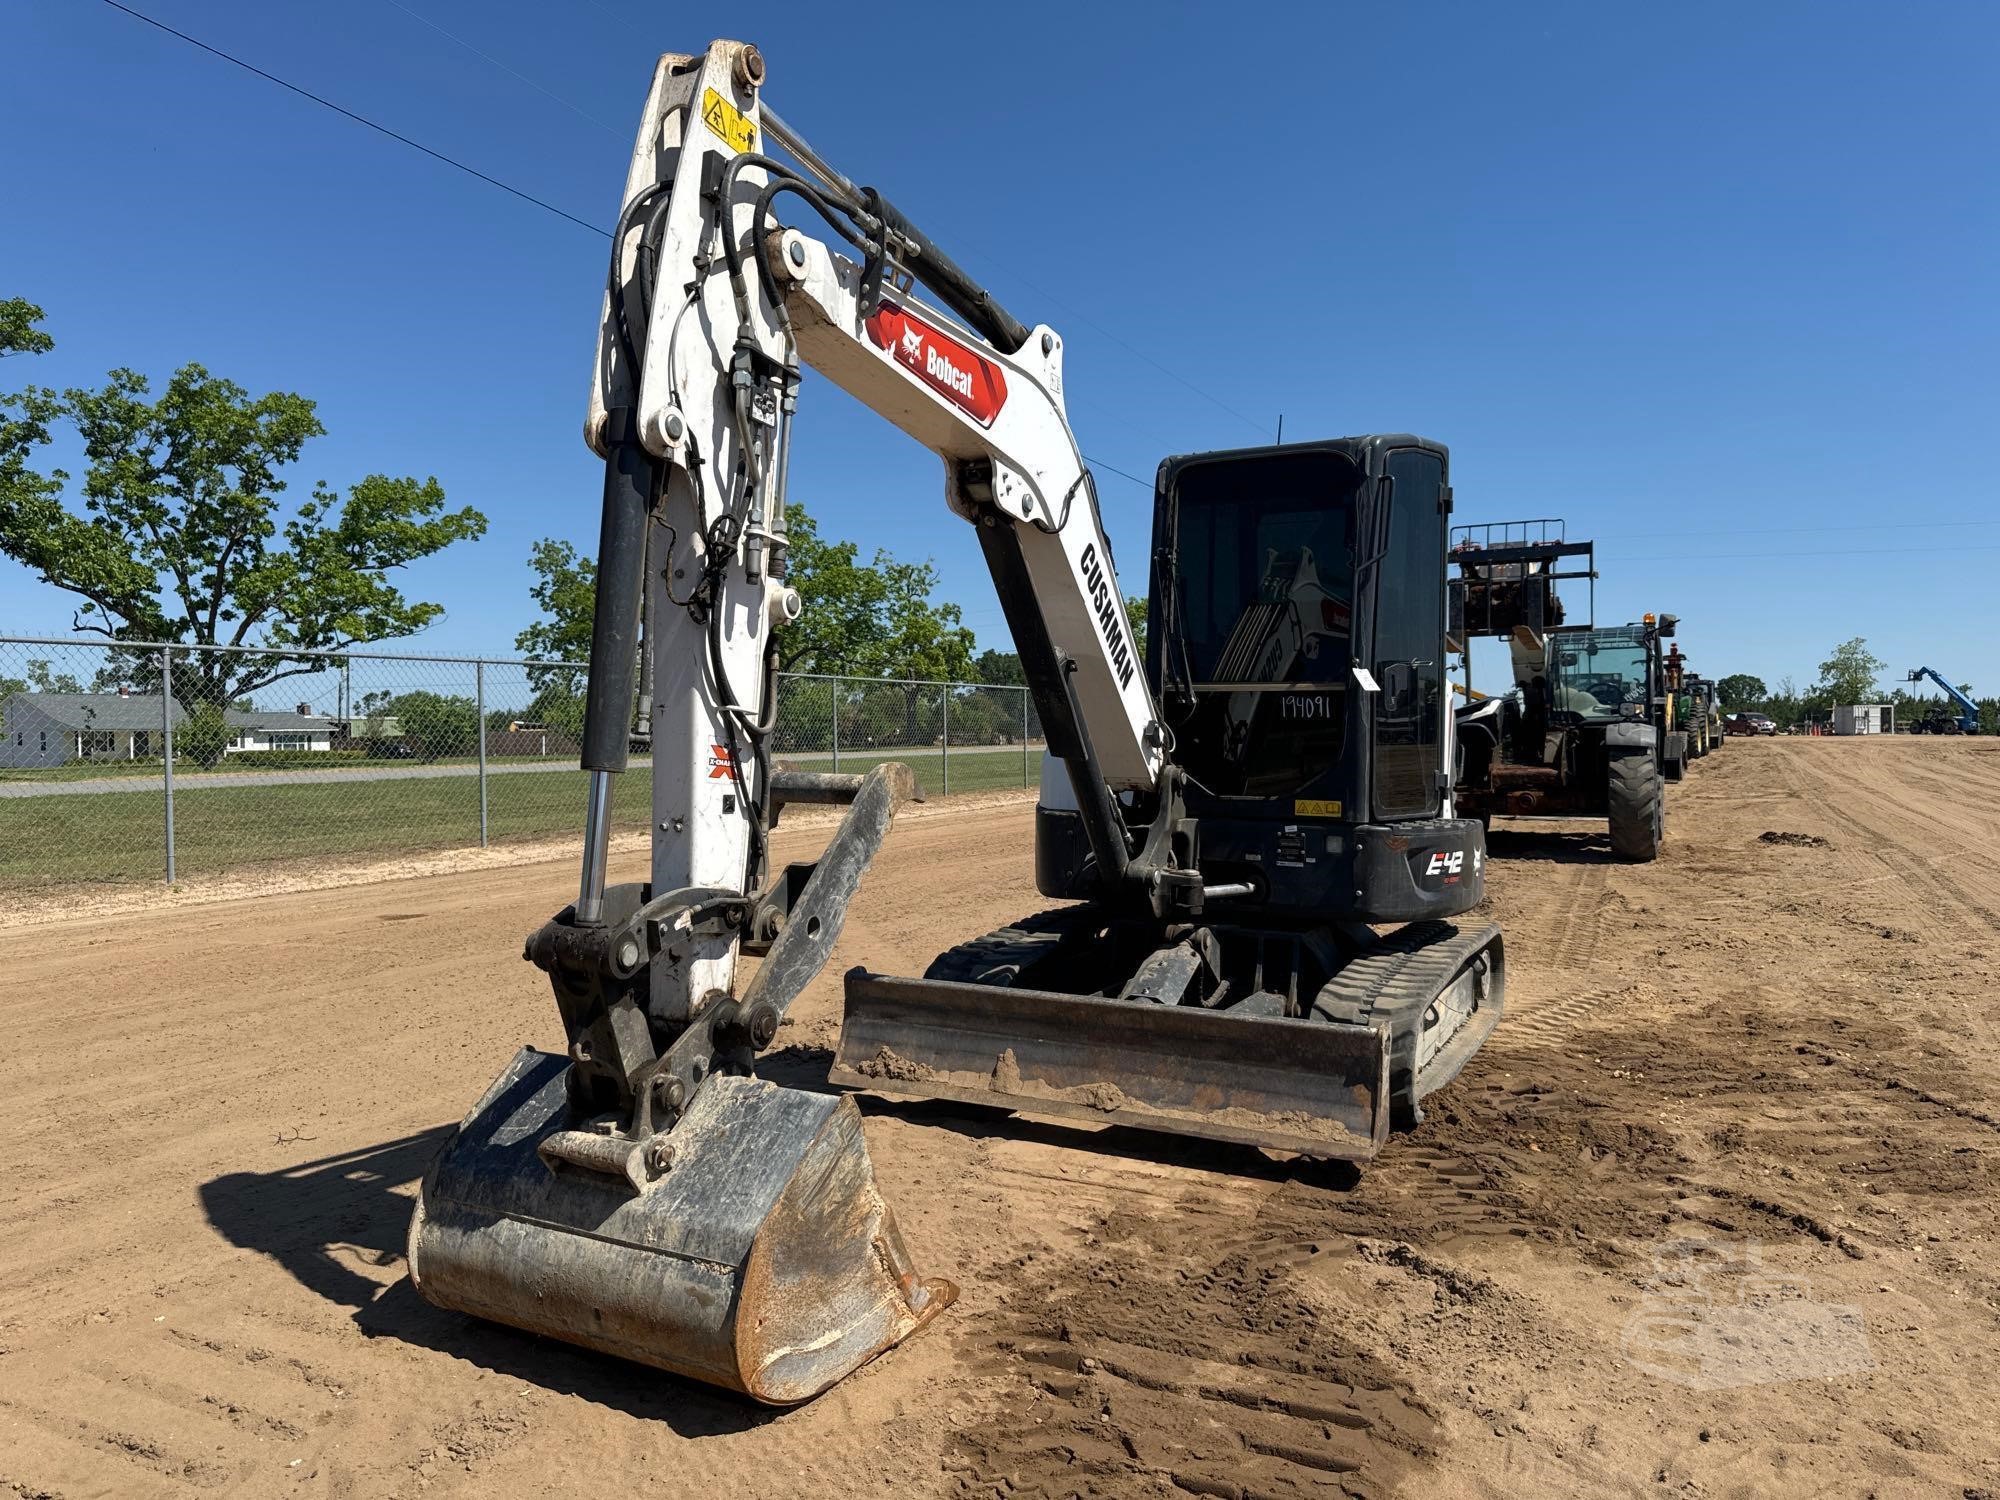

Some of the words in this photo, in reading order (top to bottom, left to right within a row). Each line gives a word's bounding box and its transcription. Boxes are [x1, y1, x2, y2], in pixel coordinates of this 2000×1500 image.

[927, 345, 973, 399] Bobcat
[1080, 542, 1134, 692] CUSHMAN
[1282, 696, 1330, 718] 194091
[1425, 851, 1464, 875] E42
